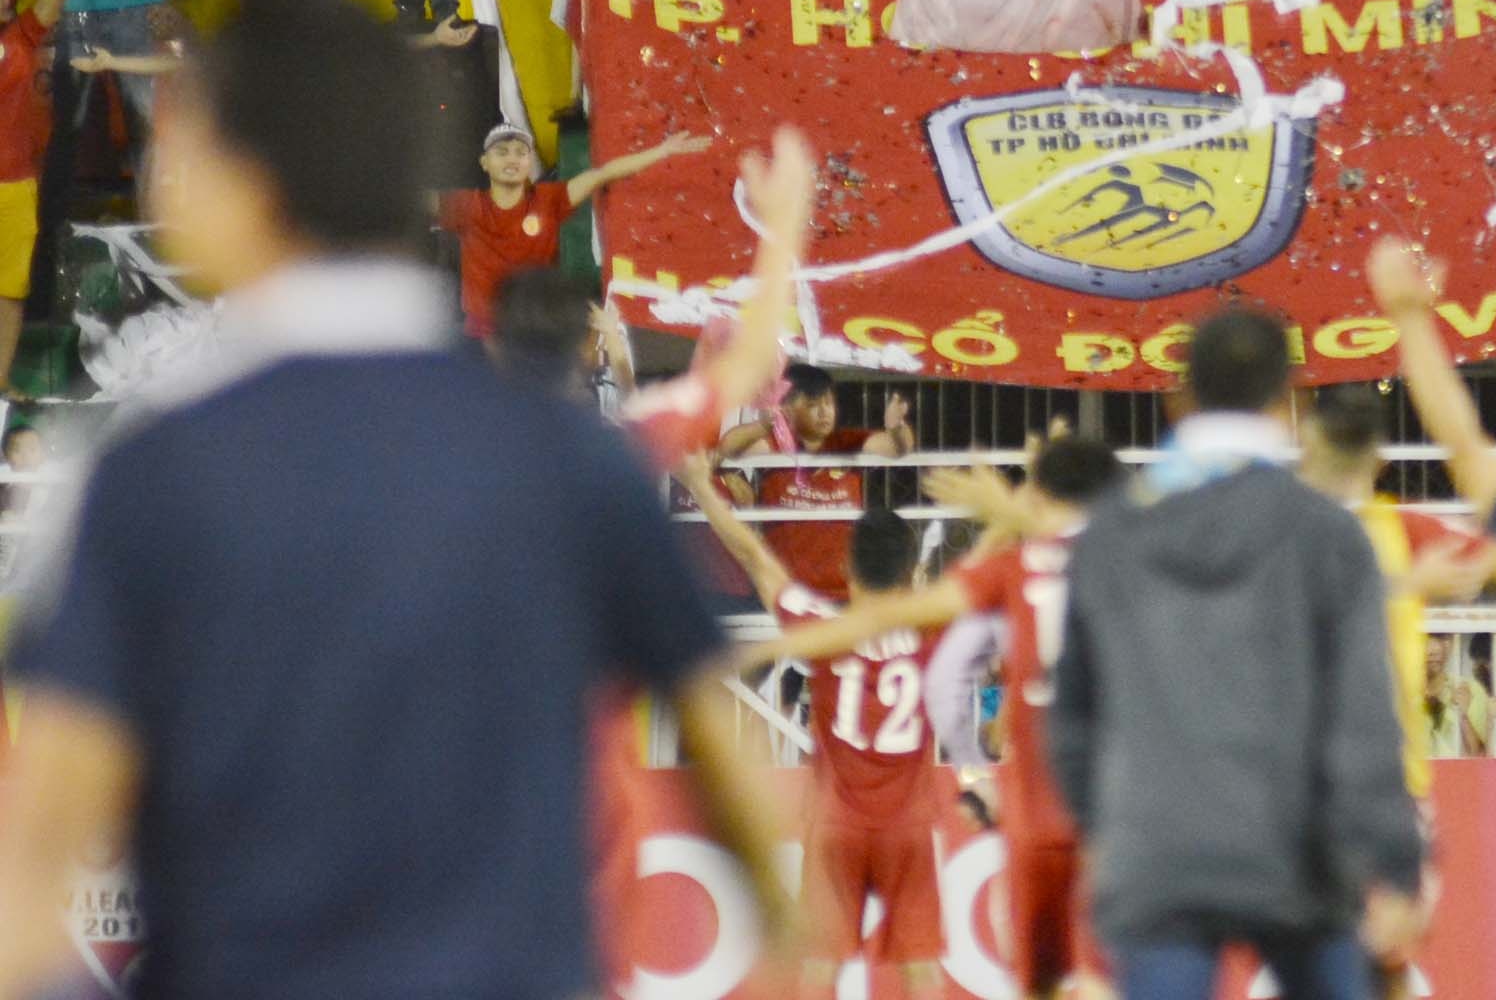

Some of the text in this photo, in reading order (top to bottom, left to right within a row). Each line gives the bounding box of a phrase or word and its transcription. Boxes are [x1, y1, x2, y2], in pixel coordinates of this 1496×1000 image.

[1007, 110, 1067, 131] CLB
[986, 137, 1026, 155] TP
[842, 310, 1019, 368] CỔ
[830, 655, 924, 753] 12
